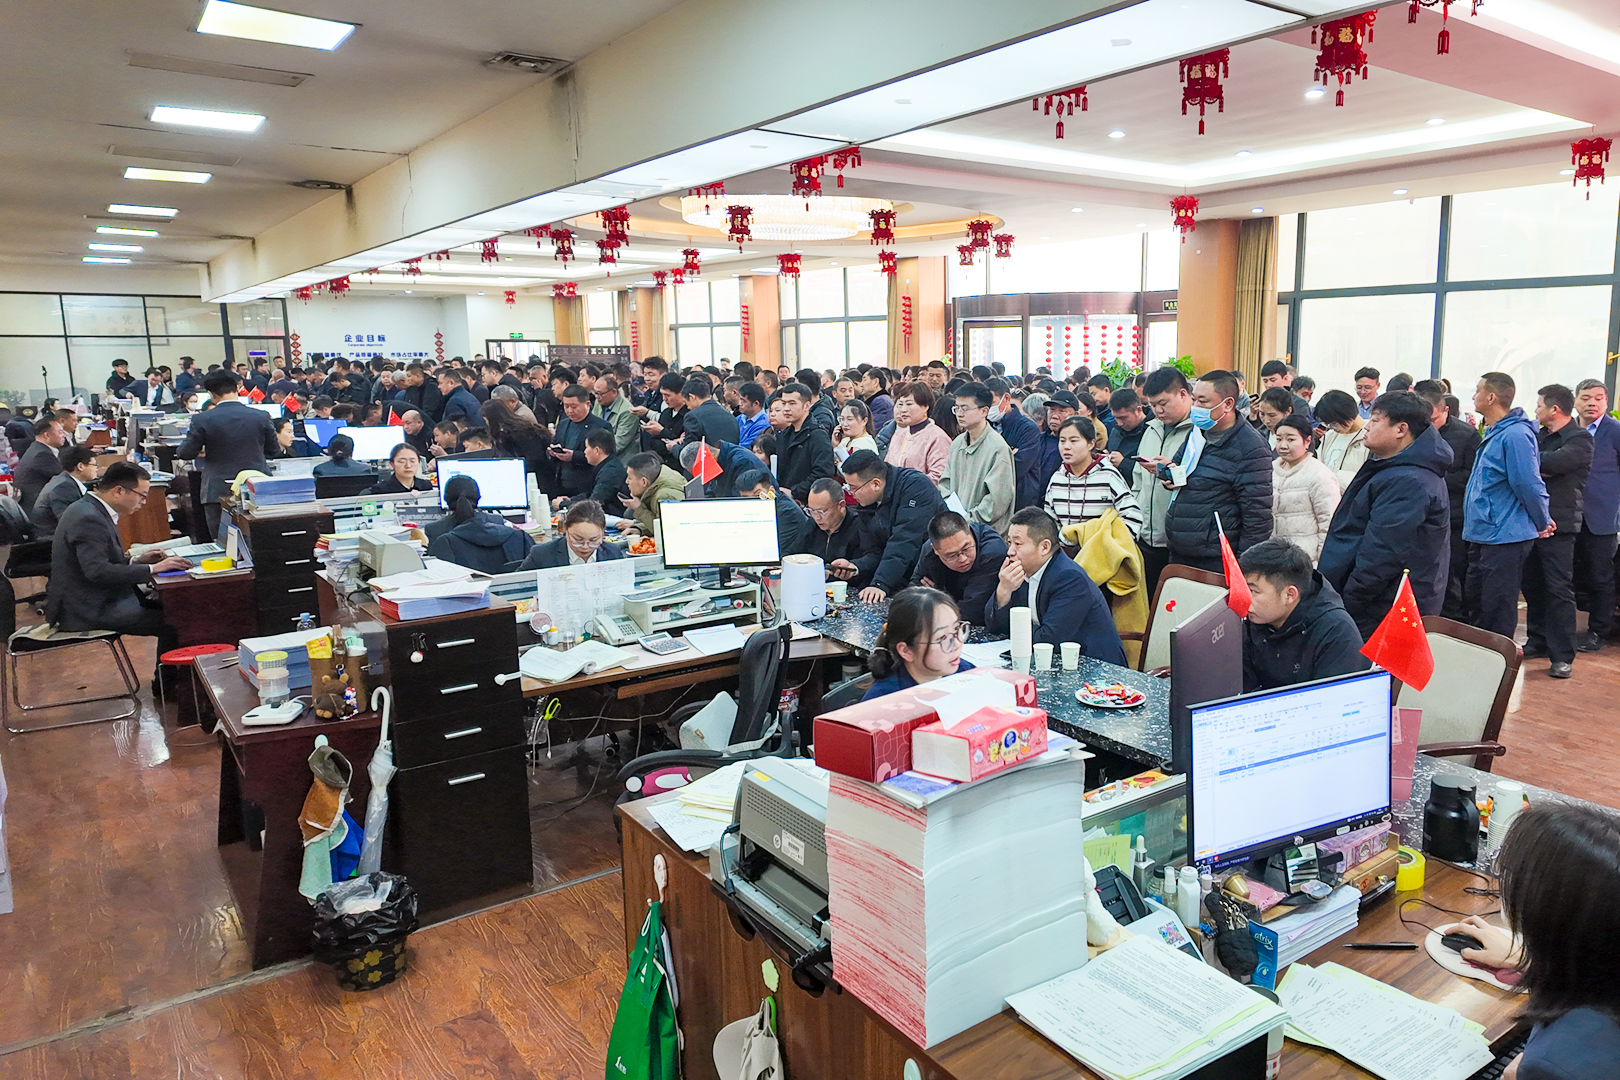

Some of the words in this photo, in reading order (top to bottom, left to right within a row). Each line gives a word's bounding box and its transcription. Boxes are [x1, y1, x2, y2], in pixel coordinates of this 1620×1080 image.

[344, 334, 386, 342] 企业目标
[1211, 621, 1225, 644] acer
[1254, 932, 1273, 946] atrix
